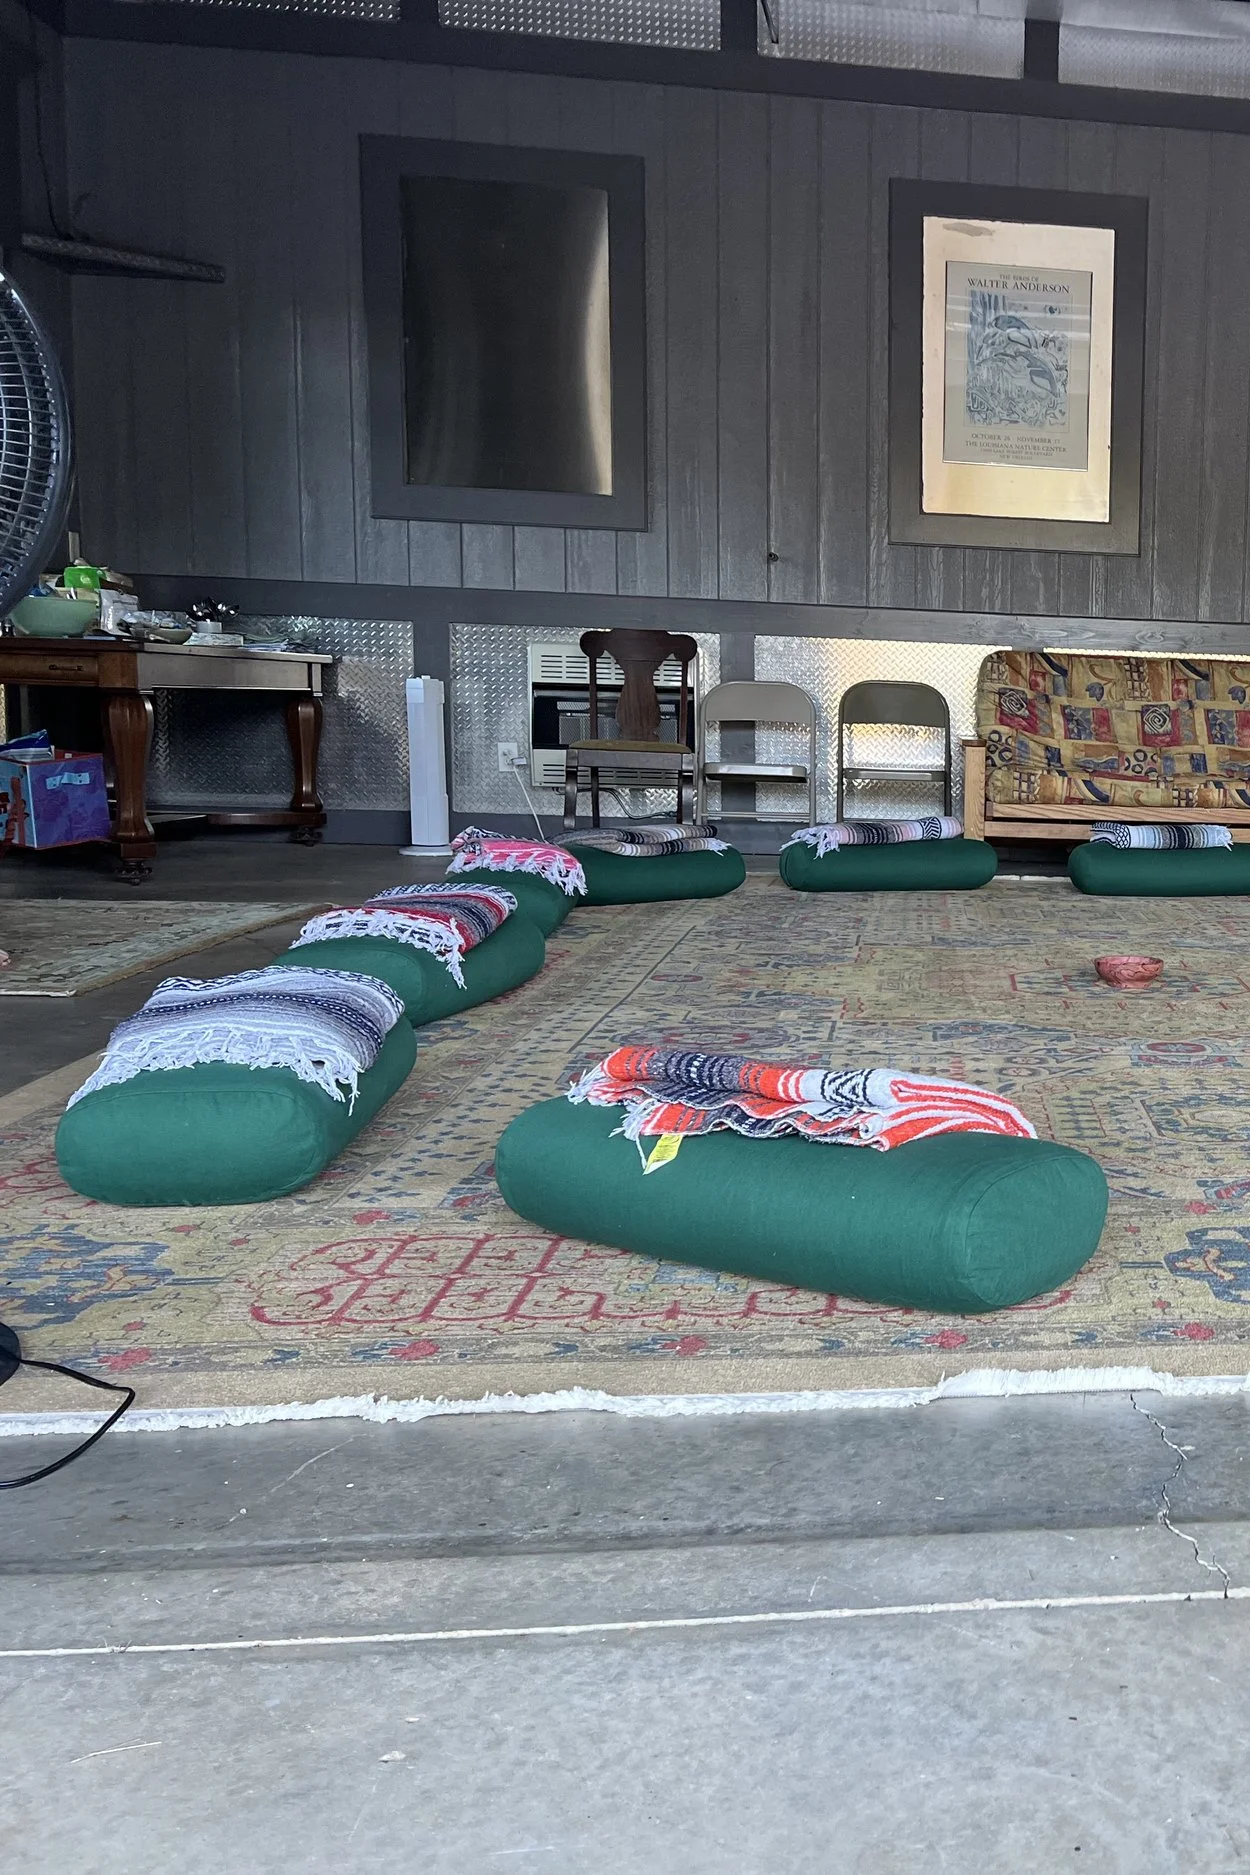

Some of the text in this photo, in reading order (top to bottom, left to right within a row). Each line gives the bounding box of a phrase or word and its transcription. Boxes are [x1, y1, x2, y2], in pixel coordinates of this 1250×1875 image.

[967, 277, 1070, 294] WALTER ANDERSON
[971, 433, 1001, 441] OCTOBER
[1016, 436, 1052, 444] NOVEMBER
[979, 441, 1014, 449] LOUISIANA
[1014, 443, 1040, 451] NATURE
